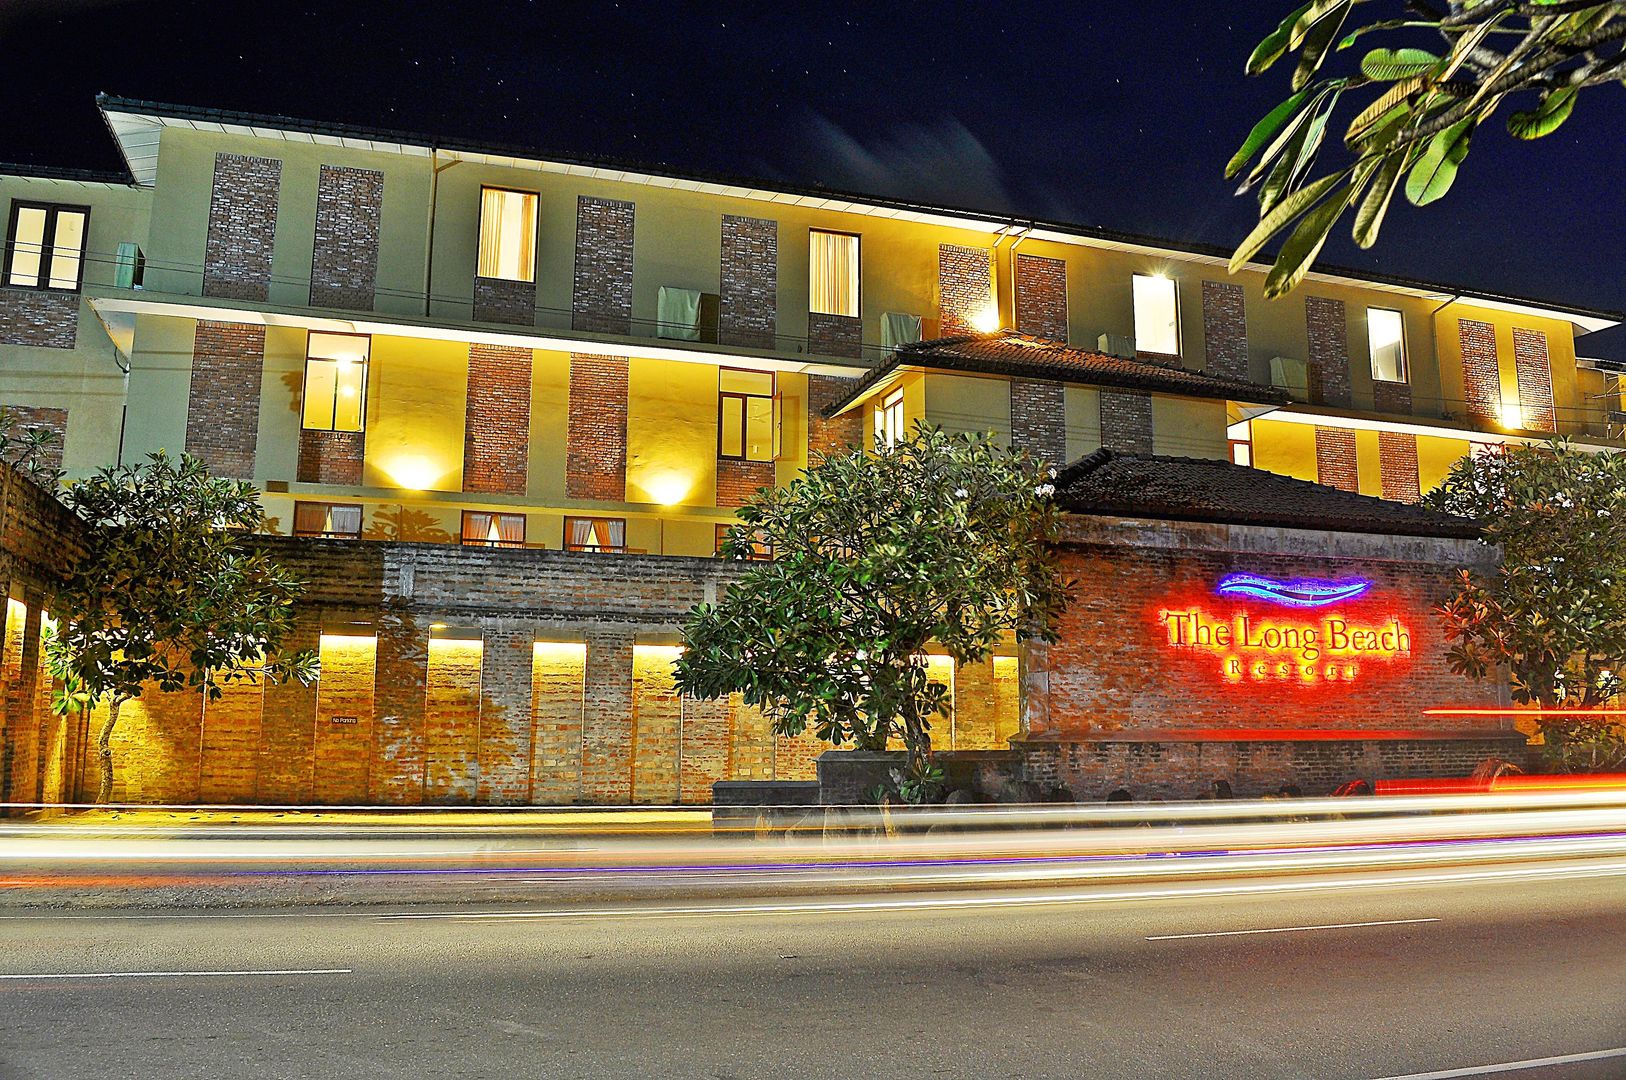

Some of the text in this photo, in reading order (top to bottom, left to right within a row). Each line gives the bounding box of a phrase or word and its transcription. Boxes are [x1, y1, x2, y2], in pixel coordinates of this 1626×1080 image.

[1165, 612, 1411, 660] The Long Beach
[1230, 659, 1358, 677] Resort
